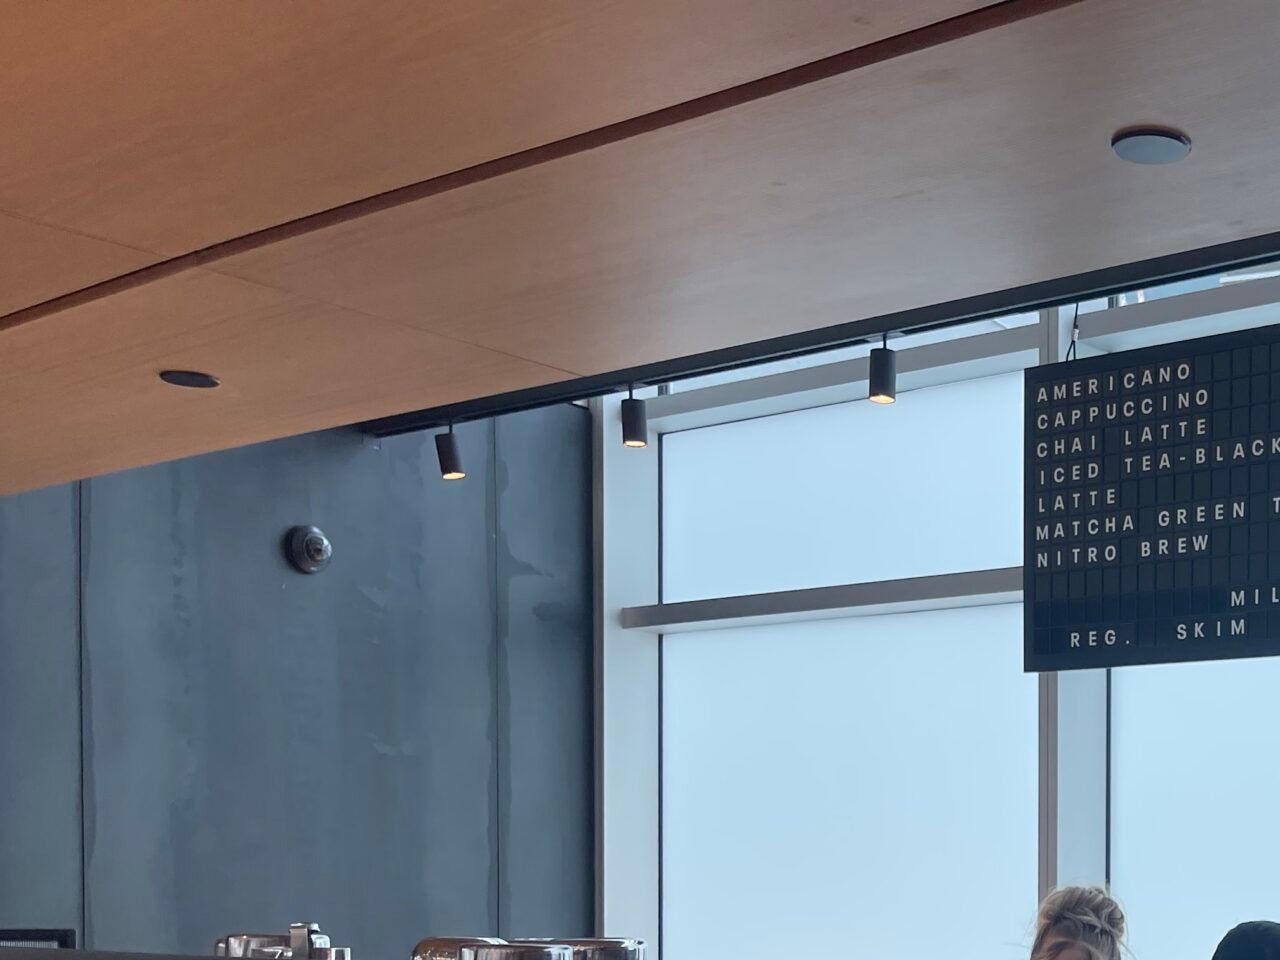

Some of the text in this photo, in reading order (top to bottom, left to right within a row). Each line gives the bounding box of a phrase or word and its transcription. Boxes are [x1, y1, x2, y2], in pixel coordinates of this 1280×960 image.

[1037, 363, 1190, 403] AMERICANO
[1037, 389, 1208, 430] CAPPUCCINO
[1036, 418, 1207, 458] CHAI LATTE
[1040, 463, 1099, 485] ICED
[1038, 488, 1115, 513] LATTE
[1036, 515, 1134, 541] MATCHA
[1158, 501, 1245, 527] GREEN
[1037, 534, 1209, 568] NITRO BREW
[1070, 629, 1131, 648] REG.
[1176, 618, 1245, 640] SKIM
